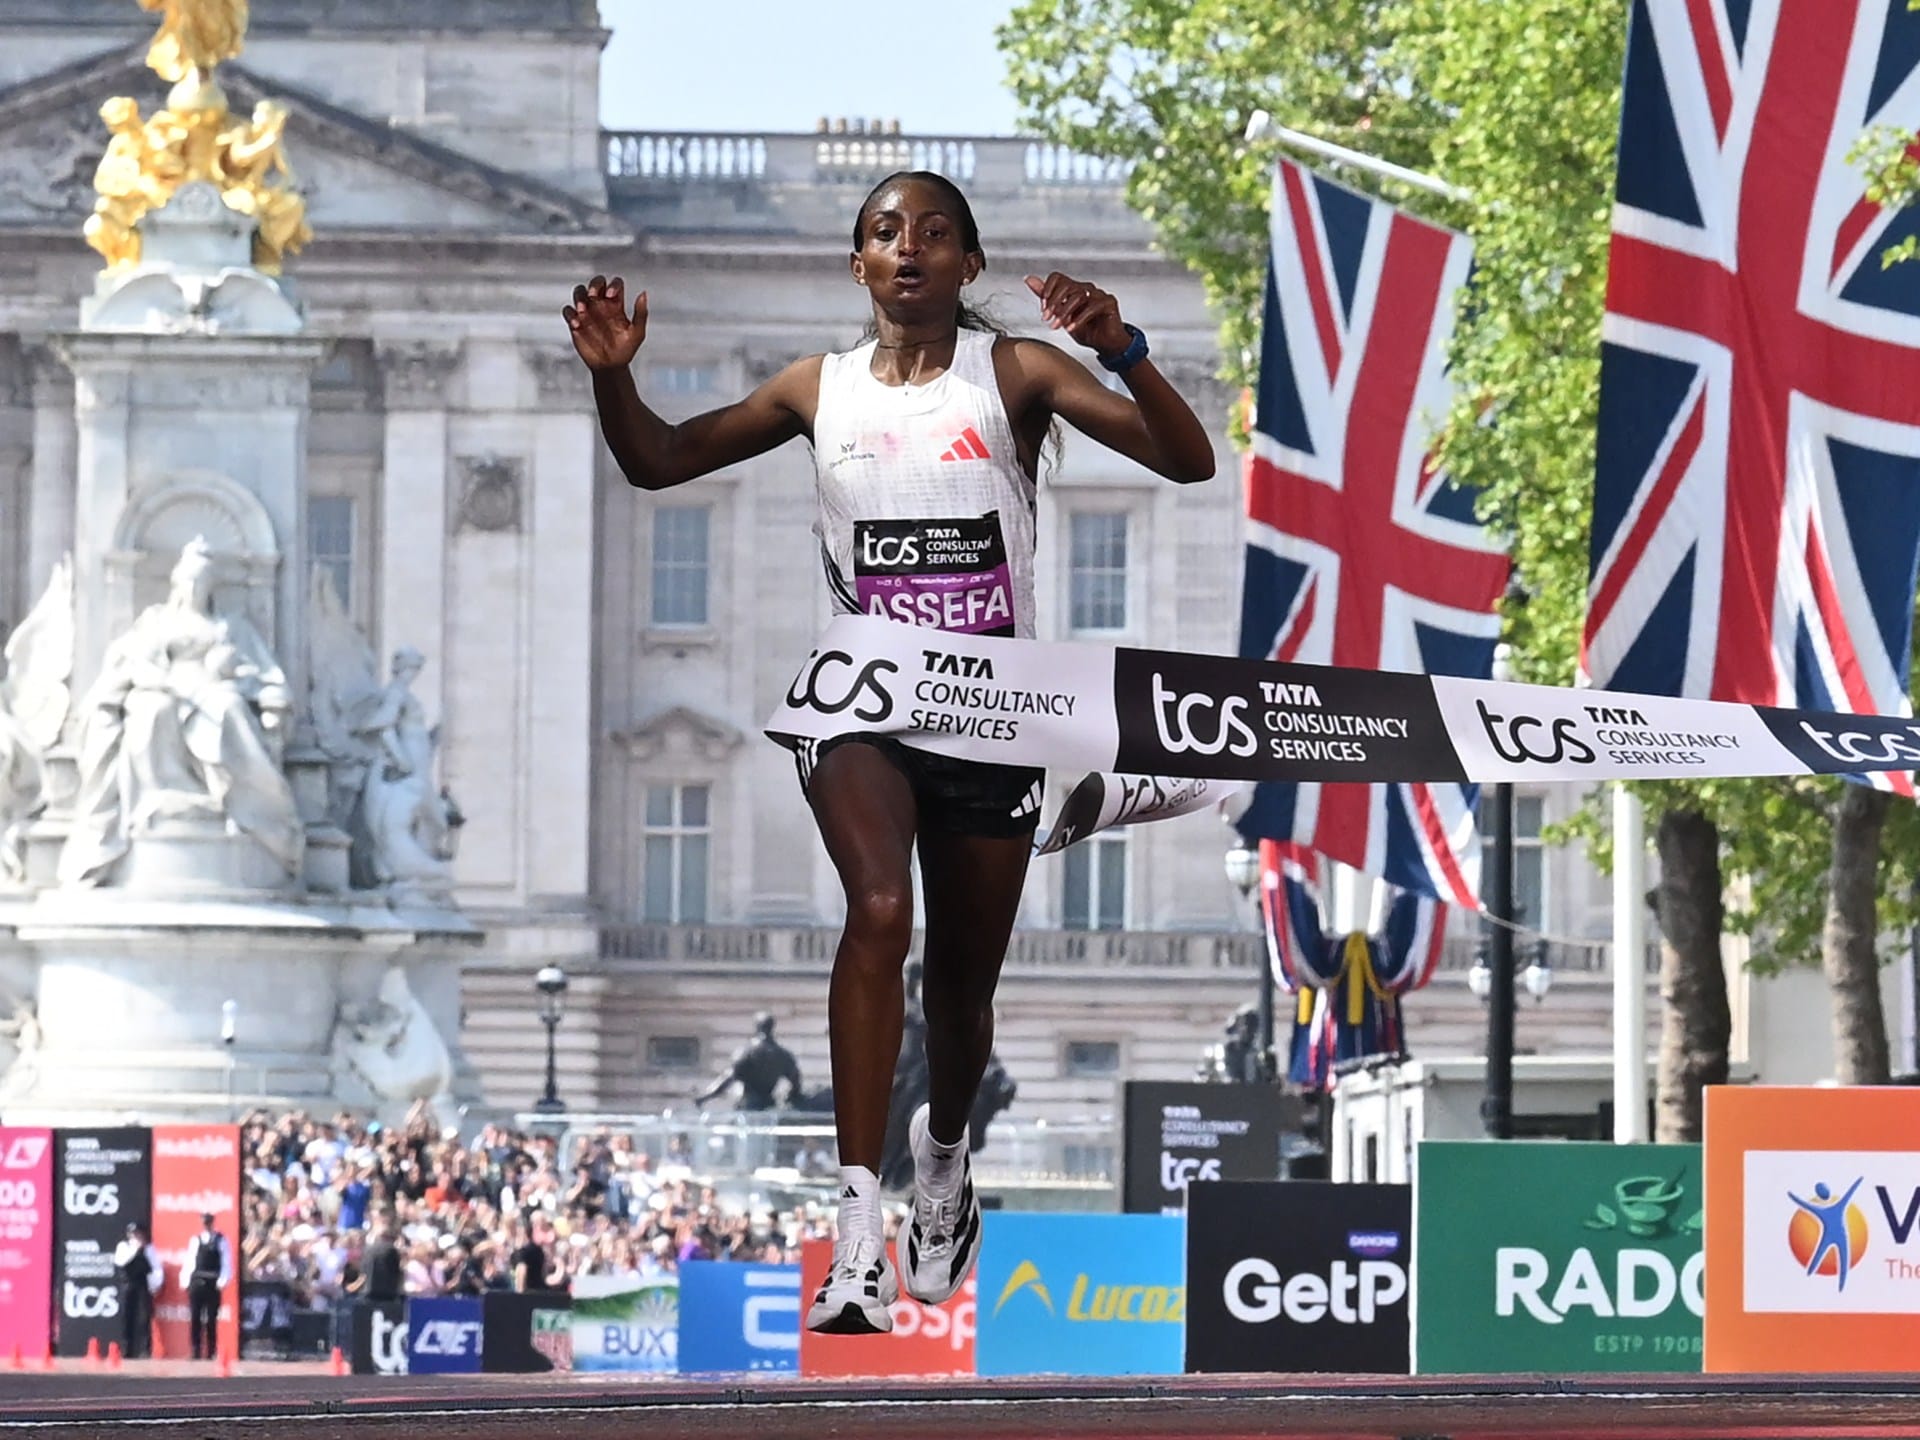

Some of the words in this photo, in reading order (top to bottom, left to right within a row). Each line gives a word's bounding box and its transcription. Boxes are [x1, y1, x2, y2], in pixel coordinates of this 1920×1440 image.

[863, 530, 920, 566] tcs
[925, 528, 961, 538] TATA
[926, 553, 980, 565] SERVICES
[868, 585, 1010, 630] ASSEFA
[921, 650, 994, 680] TATA
[914, 680, 1076, 717] CONSULTANCY
[1259, 682, 1322, 707] TATA
[908, 709, 1019, 742] SERVICES
[1152, 672, 1258, 757] tcs
[1264, 710, 1409, 738] CONSULTANCY
[1476, 699, 1596, 763] tcs
[1584, 706, 1649, 726] TATA
[1270, 738, 1367, 762] SERVICES
[1596, 729, 1741, 749] CONSULTANCY
[1799, 721, 1920, 762] tcs
[1608, 750, 1706, 764] SERVICES
[1161, 1150, 1222, 1191] tcs
[64, 1178, 119, 1215] tcs
[1875, 1185, 1920, 1245] V
[64, 1280, 119, 1318] tcs
[1223, 1257, 1407, 1324] GetP
[1653, 1335, 1703, 1354] 1908
